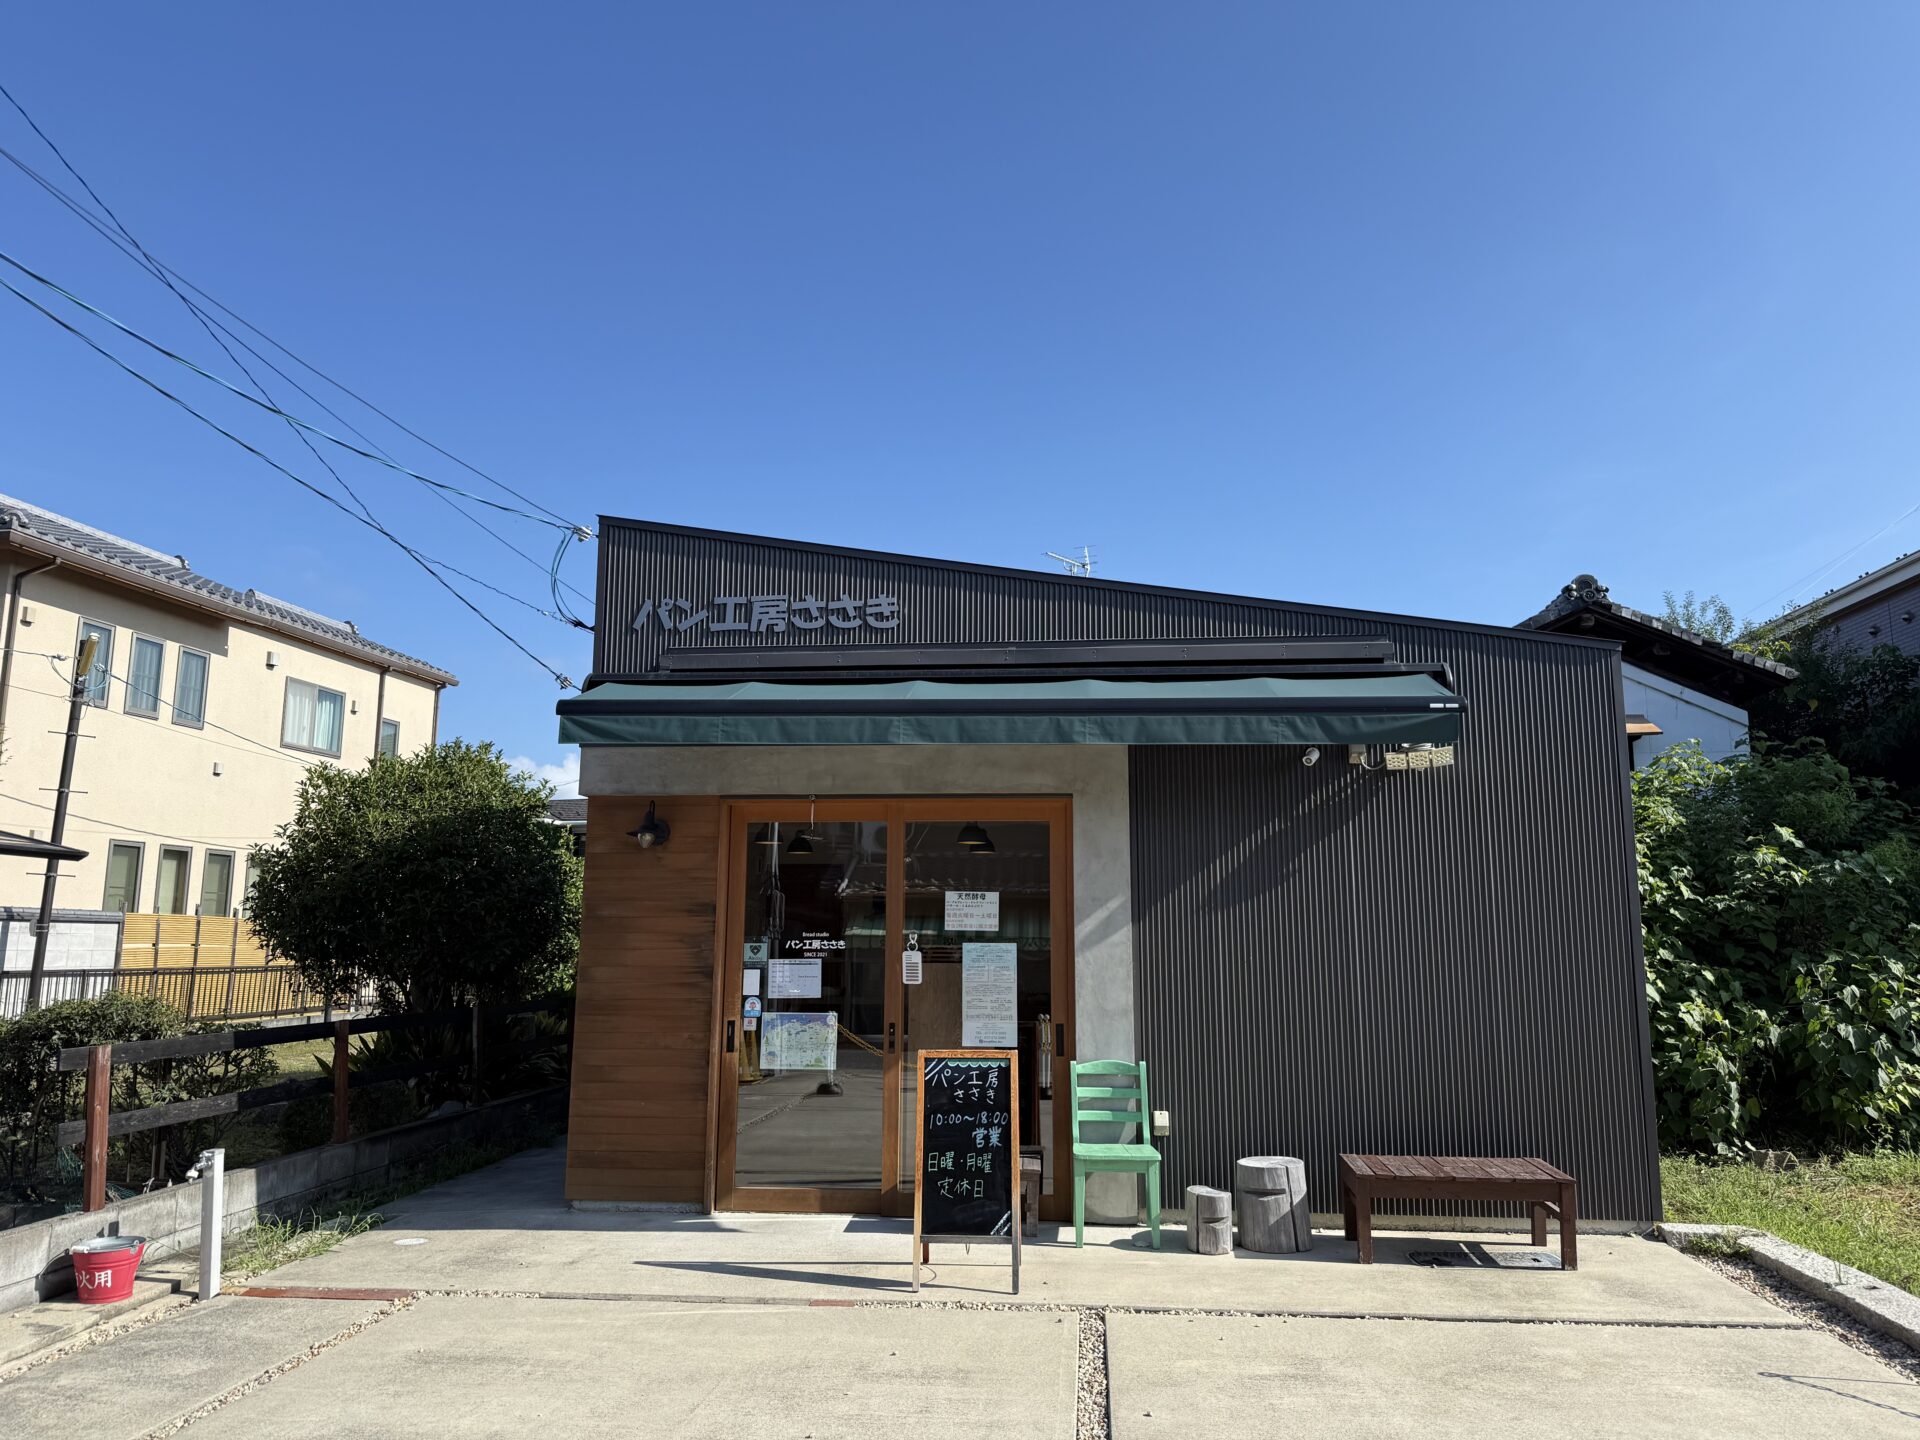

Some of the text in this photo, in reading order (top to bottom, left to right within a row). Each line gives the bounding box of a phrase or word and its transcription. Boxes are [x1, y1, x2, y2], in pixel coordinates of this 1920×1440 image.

[632, 594, 899, 632] パン工房ささき
[957, 892, 986, 900] 天然酵母
[785, 939, 846, 949] パン工房ささき
[931, 1068, 999, 1088] パン工房
[953, 1087, 996, 1105] ささき
[971, 1126, 1003, 1149] 営業
[937, 1178, 984, 1199] 定休日
